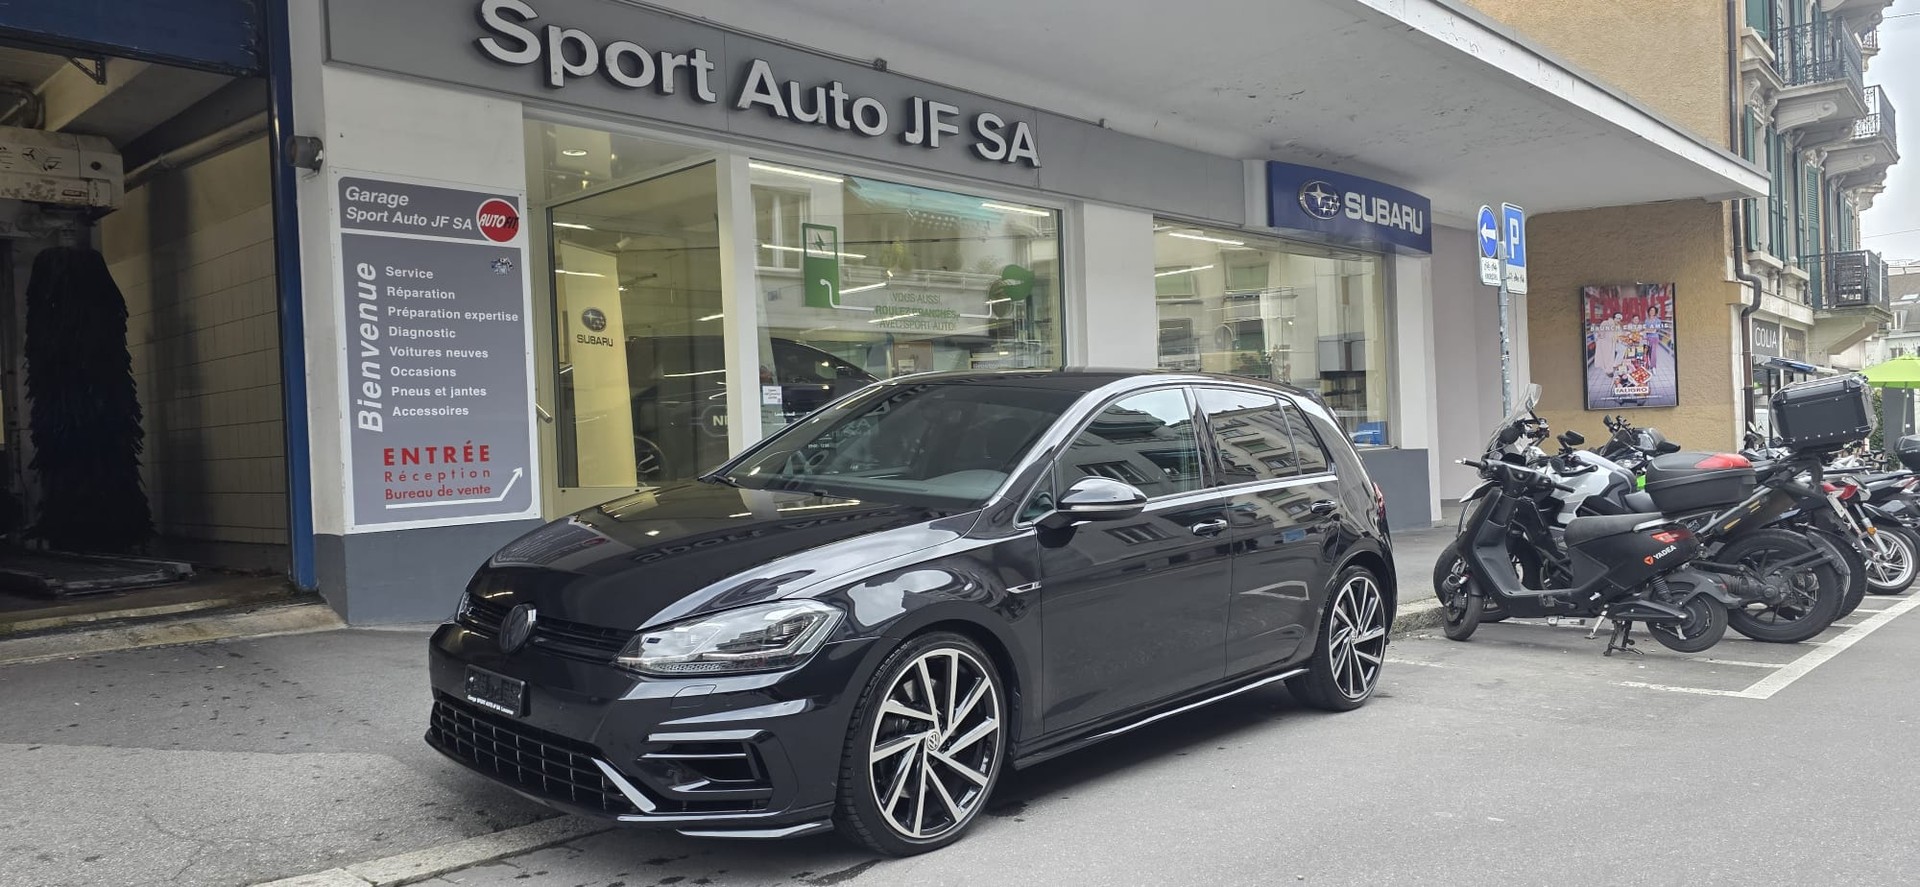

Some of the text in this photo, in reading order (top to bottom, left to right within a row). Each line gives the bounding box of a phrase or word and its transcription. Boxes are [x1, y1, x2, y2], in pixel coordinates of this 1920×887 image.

[477, 0, 1041, 168] Sport Auto JF SA
[345, 186, 409, 208] Garage
[346, 206, 472, 230] Sport Auto JF SA
[1345, 192, 1423, 235] SUBARU
[1510, 217, 1519, 259] P
[385, 266, 434, 279] Service
[387, 286, 456, 300] Réparation
[388, 306, 518, 322] Préparation expertise
[389, 326, 456, 340] Diagnostic
[576, 334, 613, 347] SUBARU
[357, 262, 383, 433] Bienvenue
[389, 346, 489, 359] Voitures neuves
[390, 366, 457, 377] Occasions
[391, 386, 487, 399] Pneus et jantes
[392, 405, 469, 417] Accessoires
[384, 440, 490, 466] ENTRÉE
[384, 467, 491, 484] Réception
[385, 484, 491, 500] Bureau de vente
[1653, 545, 1677, 560] YADEA
